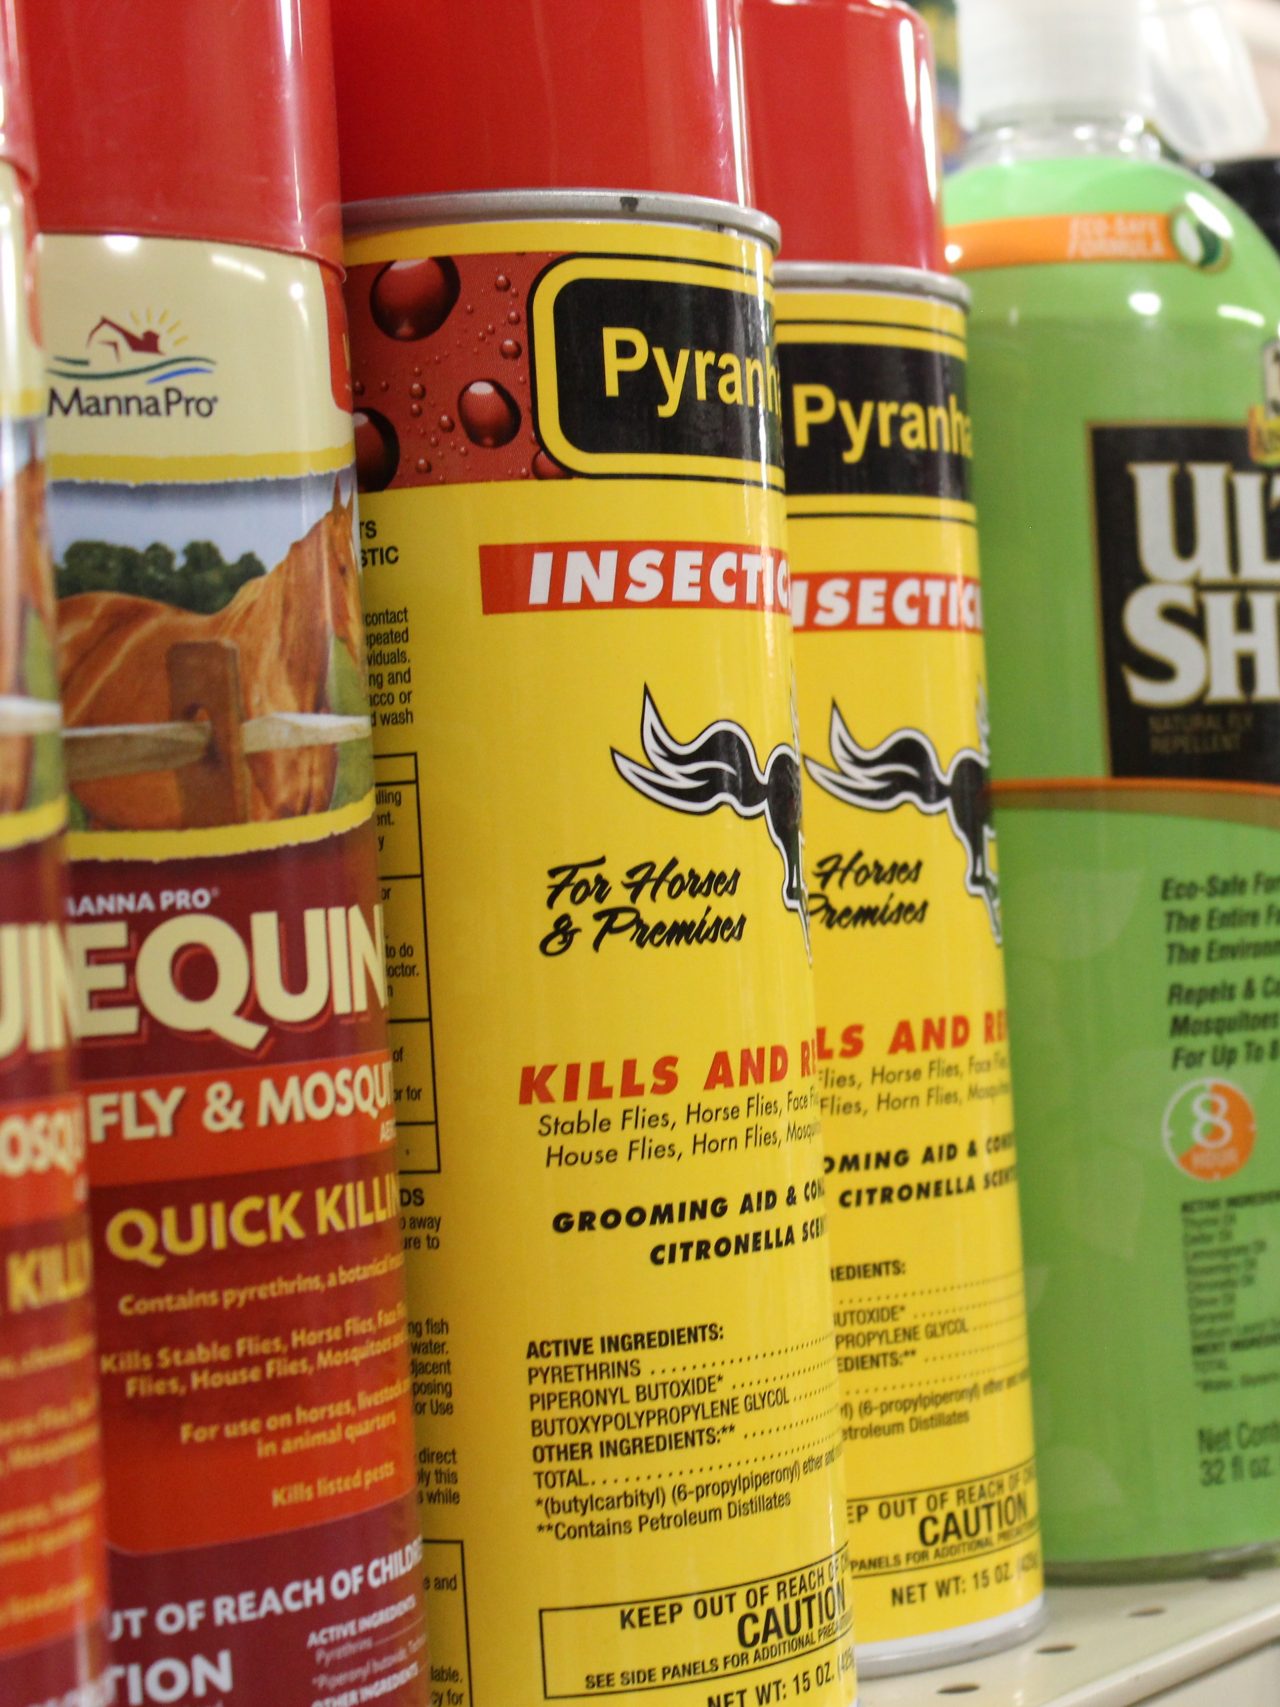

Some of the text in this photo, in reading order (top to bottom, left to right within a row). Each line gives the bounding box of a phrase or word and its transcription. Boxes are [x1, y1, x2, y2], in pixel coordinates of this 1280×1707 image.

[602, 327, 781, 417] Pyranh
[528, 550, 791, 607] INSECTIC
[365, 607, 408, 627] contact
[387, 667, 411, 685] and
[399, 690, 413, 704] or
[380, 708, 414, 726] wash
[547, 856, 741, 909] For Horses
[812, 849, 922, 891] Horses
[539, 905, 747, 957] & Premises
[1165, 911, 1201, 935] The
[399, 943, 414, 958] do
[1167, 942, 1201, 965] The
[887, 1015, 970, 1055] AND
[871, 1064, 922, 1086] Horse
[929, 1057, 963, 1079] Flies,
[1171, 1047, 1206, 1071] For
[1211, 1044, 1238, 1070] Up
[1244, 1039, 1265, 1064] To
[519, 1045, 788, 1104] KILLS AND
[87, 1081, 244, 1144] FLY &
[537, 1106, 611, 1136] Stable
[621, 1106, 677, 1130] Flies,
[686, 1102, 740, 1125] Horse
[746, 1093, 782, 1117] Flies,
[876, 1092, 920, 1112] Horn
[927, 1086, 962, 1107] Flies,
[1191, 1090, 1233, 1149] 8
[546, 1123, 782, 1168] House Flies, Horn Flies,
[922, 1143, 957, 1164] AID
[552, 1185, 797, 1233] GROOMING AID &
[839, 1175, 976, 1208] CITRONELLA
[105, 1192, 305, 1268] QUICK
[650, 1225, 795, 1266] CITRONELLA
[118, 1288, 219, 1317] Contains
[425, 1318, 449, 1334] fish
[526, 1322, 724, 1359] ACTIVE INGREDIENTS:
[101, 1348, 152, 1374] Kills
[157, 1341, 231, 1369] Stable
[236, 1332, 288, 1358] Flies,
[291, 1326, 342, 1349] Horse
[126, 1353, 314, 1398] Flies, House Flies,
[528, 1358, 641, 1385] PYRETHRINS
[530, 1386, 630, 1411] PIPERONYL
[531, 1386, 790, 1438] BUTOXYPOLYPROPYLENE GLYCOL
[181, 1421, 219, 1444] For
[224, 1417, 262, 1438] use
[266, 1411, 293, 1432] on
[257, 1423, 342, 1458] in animal
[419, 1448, 457, 1464] direct
[532, 1440, 593, 1464] OTHER
[272, 1482, 314, 1509] Kills
[318, 1470, 362, 1498] listed
[434, 1469, 458, 1484] this
[672, 1460, 801, 1502] (6-propylpiperonyl)
[1200, 1457, 1226, 1487] 32
[426, 1488, 460, 1504] while
[638, 1505, 722, 1533] Petroleum
[728, 1491, 791, 1520] Distillates
[878, 1480, 1005, 1520] OUT OF REACH
[919, 1490, 1029, 1547] CAUTION
[851, 1554, 901, 1572] PANELS
[906, 1549, 930, 1564] FOR
[155, 1563, 363, 1635] OF REACH OF
[434, 1574, 457, 1590] and
[619, 1566, 825, 1630] KEEP OUT OF REACH
[891, 1583, 928, 1608] NET
[935, 1576, 967, 1599] WT:
[973, 1571, 991, 1591] 15
[738, 1577, 846, 1650] CAUTION
[585, 1634, 816, 1690] SEE SIDE PANELS FOR ADDITIONAL
[756, 1681, 787, 1706] WT:
[793, 1674, 811, 1695] 15
[816, 1662, 835, 1684] OZ.
